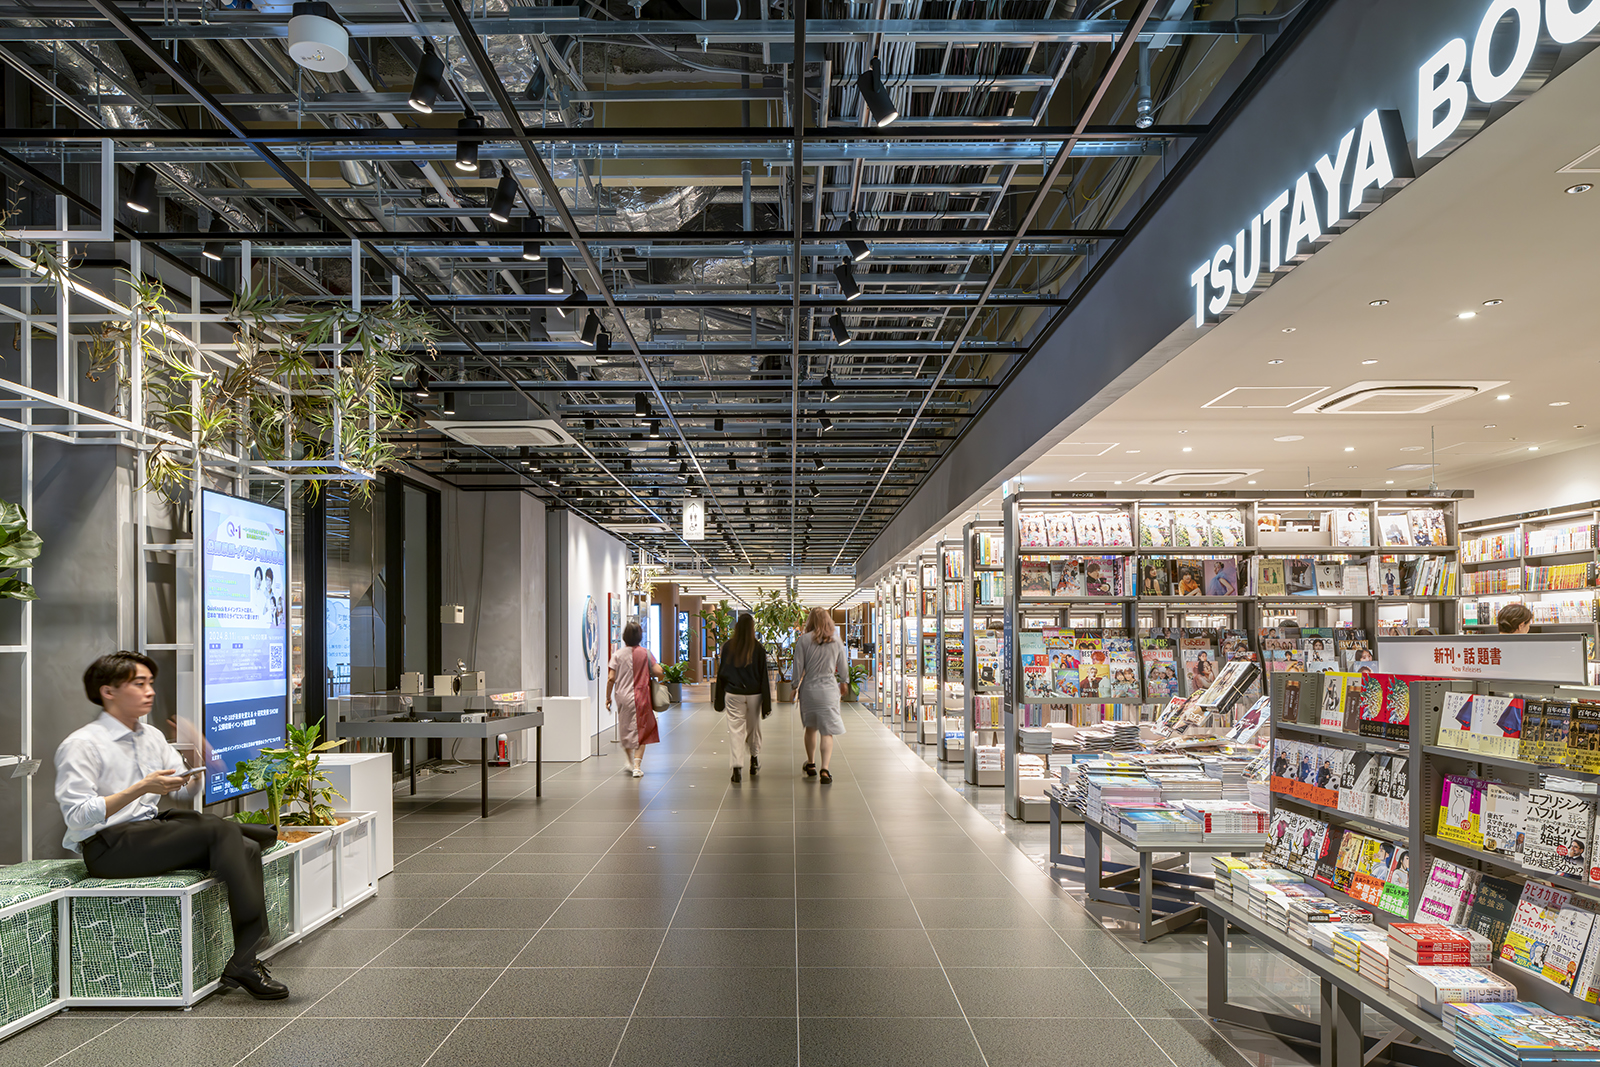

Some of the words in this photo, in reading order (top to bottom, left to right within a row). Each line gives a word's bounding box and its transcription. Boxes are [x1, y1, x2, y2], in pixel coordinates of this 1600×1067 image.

[1191, 109, 1394, 328] TSUTAYA
[1434, 647, 1502, 665] 新刊・話題書
[1527, 806, 1562, 820] バブル
[1518, 900, 1539, 914] どこへ
[1514, 913, 1556, 937] いったのか?
